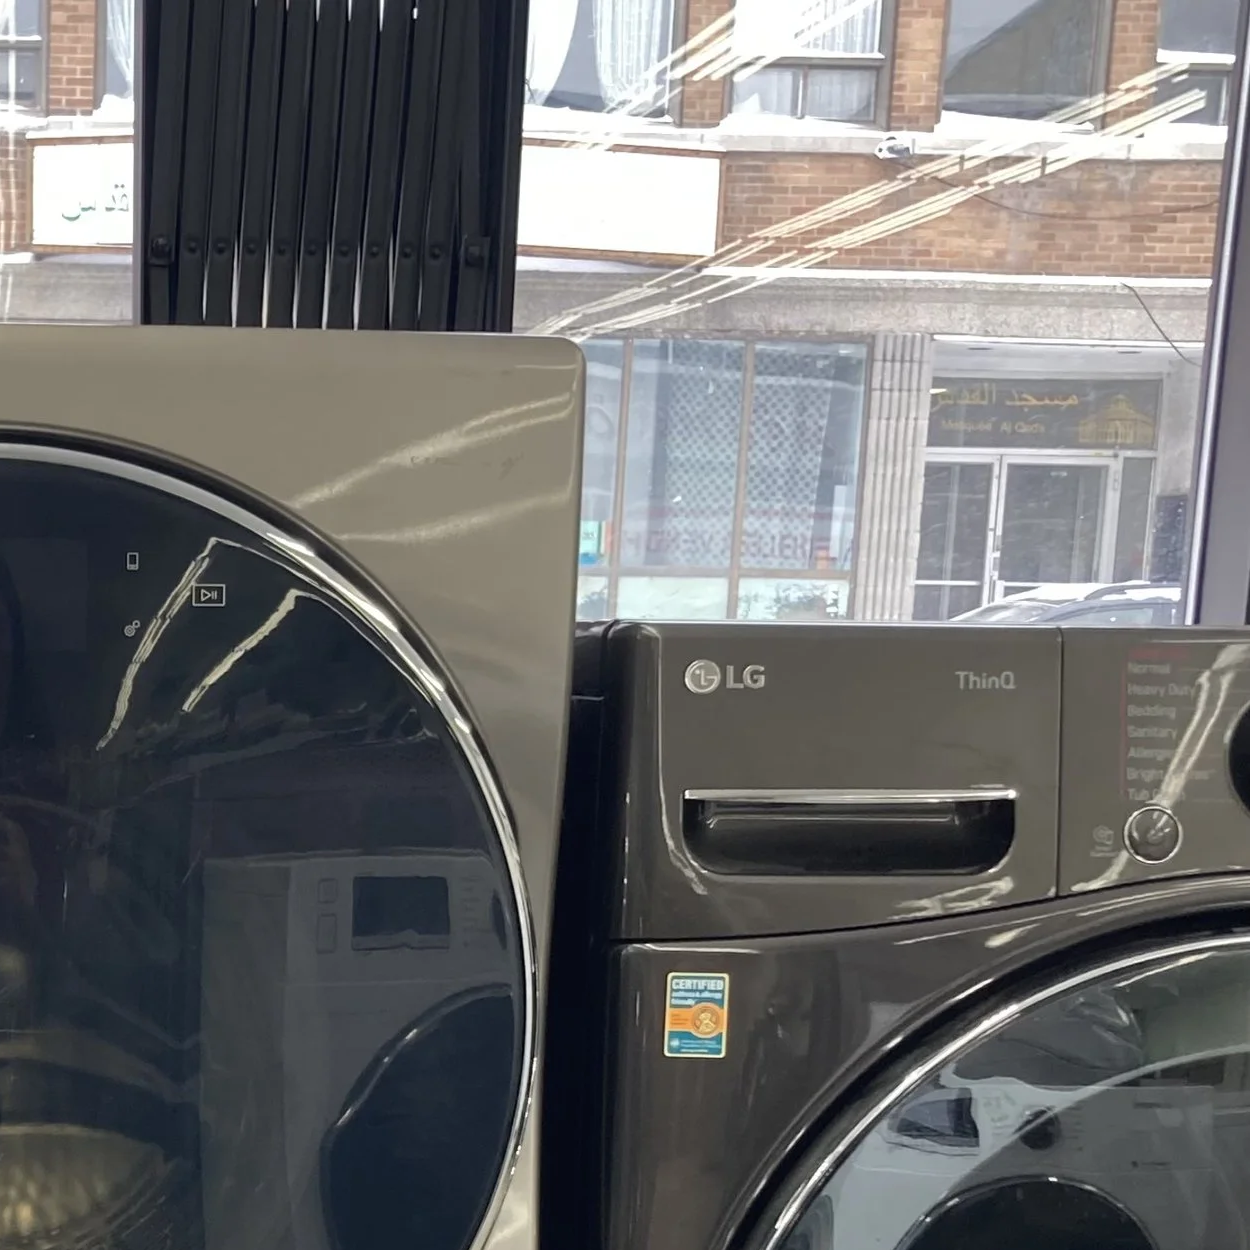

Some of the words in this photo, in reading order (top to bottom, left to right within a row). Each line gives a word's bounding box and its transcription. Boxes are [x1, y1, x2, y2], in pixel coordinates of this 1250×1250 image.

[1127, 663, 1171, 674] Normal
[725, 664, 766, 689] LG
[954, 671, 1017, 690] ThinQ
[1127, 683, 1165, 696] Heavy
[1168, 683, 1196, 698] Duty
[1127, 705, 1177, 719] Bedding
[1127, 726, 1178, 740] Sanitary
[672, 979, 724, 990] CERTIFIED
